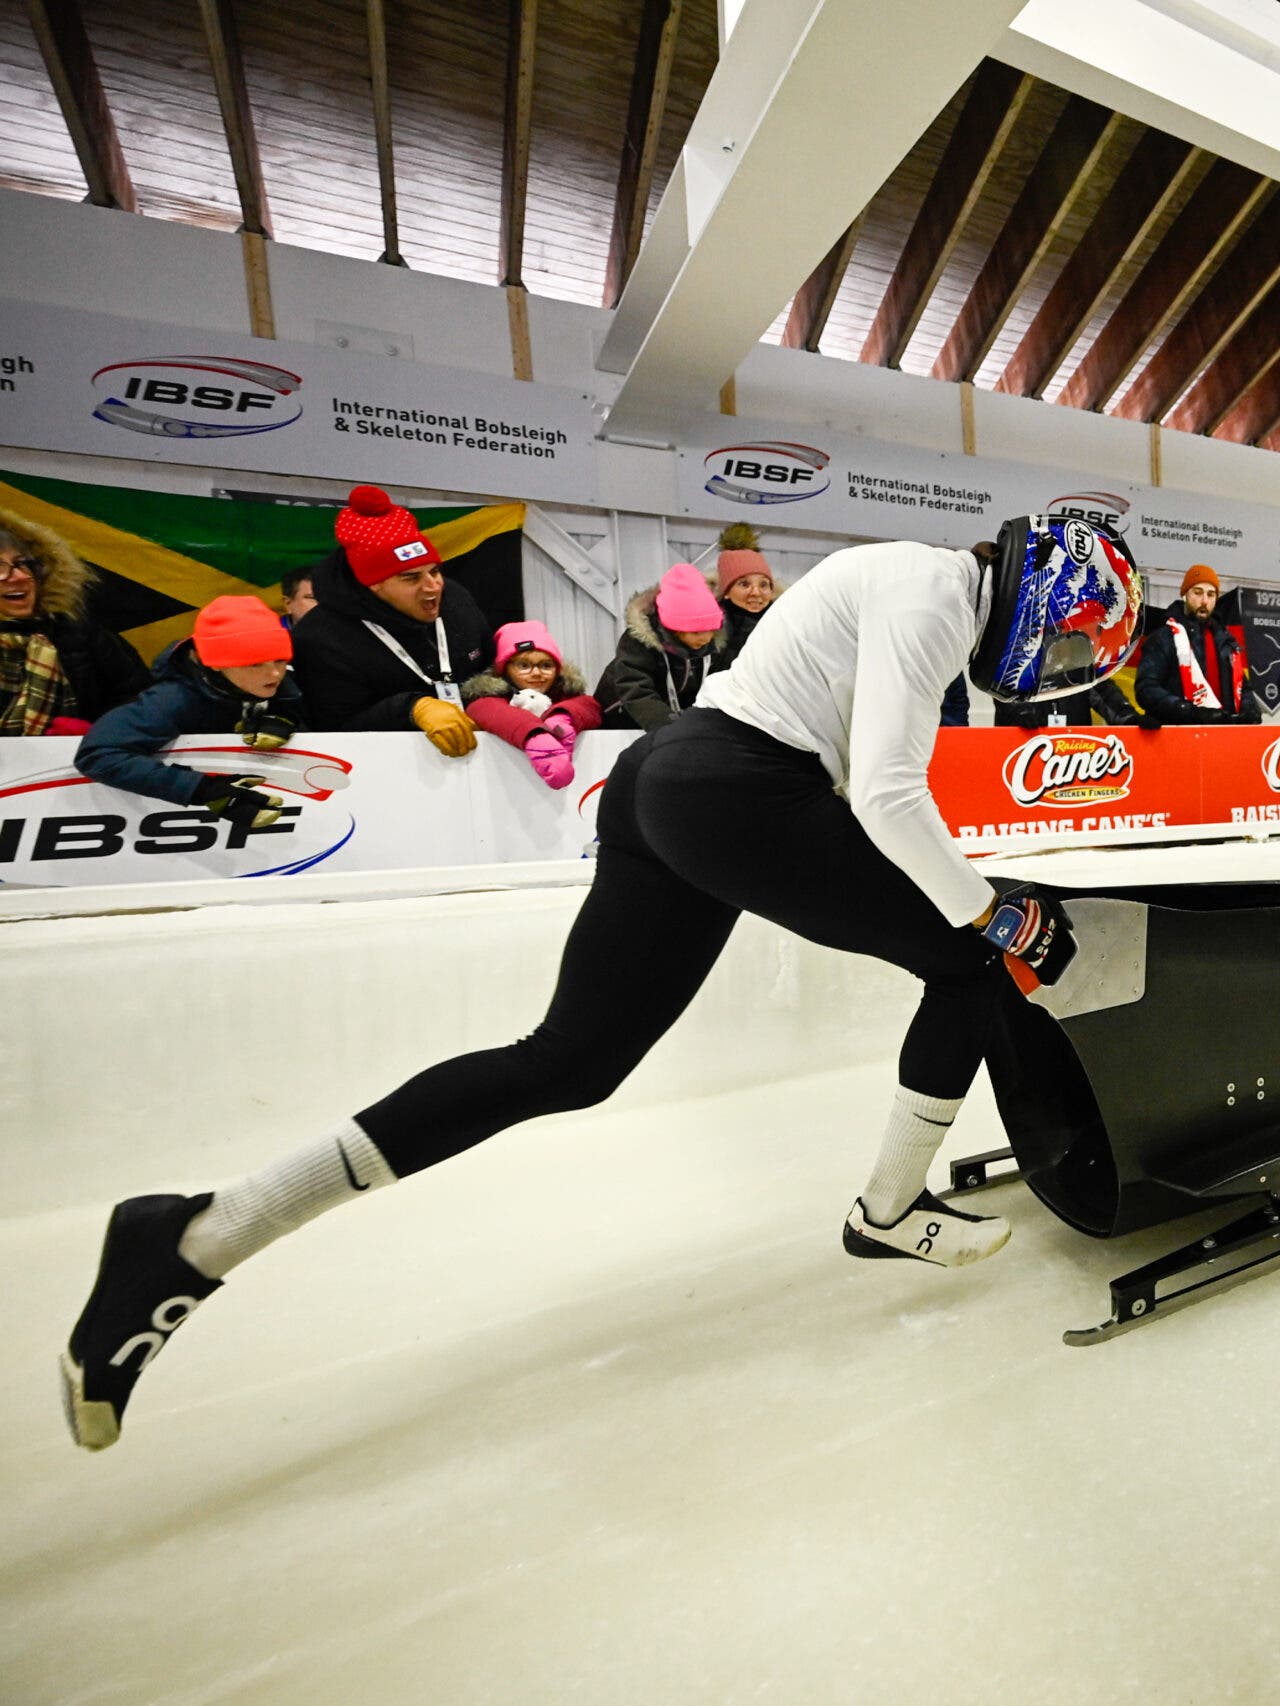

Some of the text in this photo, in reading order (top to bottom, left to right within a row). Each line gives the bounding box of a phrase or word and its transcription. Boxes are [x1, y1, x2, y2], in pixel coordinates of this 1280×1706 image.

[125, 377, 276, 412] IBSF
[332, 398, 567, 445] International Bobsleigh
[334, 417, 555, 459] & Skeleton Federation
[723, 459, 814, 484] IBSF
[848, 472, 991, 503] International Bobsleigh
[849, 486, 984, 515] & Skeleton Federation
[1073, 521, 1091, 560] Arai
[1141, 515, 1243, 539] International Bobsleigh
[1141, 528, 1238, 548] & Skeleton Federation
[1055, 739, 1096, 754] Raising
[1011, 735, 1131, 802] Cane's
[1053, 790, 1086, 799] CHICKEN
[0, 806, 302, 863] IBSF
